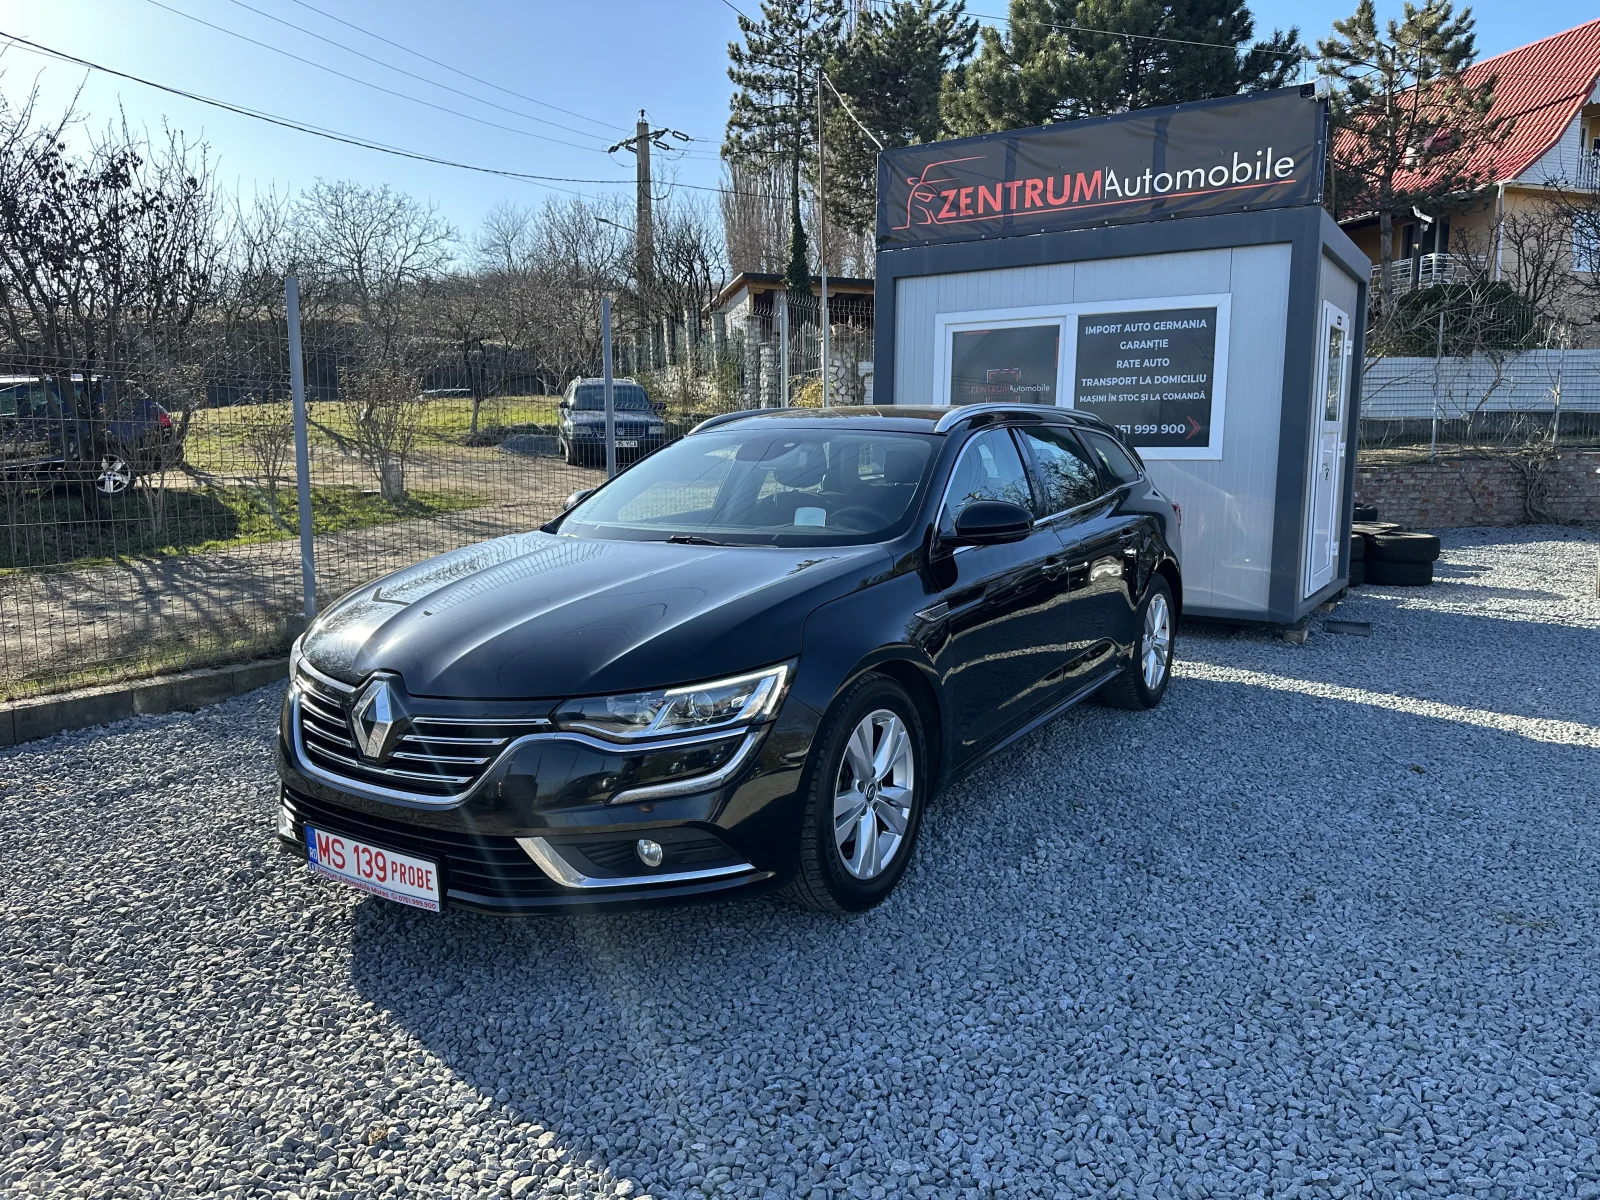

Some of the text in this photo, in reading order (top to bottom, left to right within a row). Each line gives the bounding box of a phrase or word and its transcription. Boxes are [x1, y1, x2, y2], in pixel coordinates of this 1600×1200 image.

[938, 147, 1295, 219] ZENTRUM Automobile
[1085, 319, 1207, 335] IMPORT AUTO GERMANIA
[1119, 339, 1169, 351] GARANȚIE
[1116, 358, 1170, 369] RATE AUTO
[1081, 374, 1207, 387] TRANSPORT LA DOMICILIU
[970, 383, 1050, 394] ZENTRUM Automobile
[1079, 390, 1206, 404] MAȘINI ÎN STOC ȘI LA COMANDĂ
[1134, 424, 1158, 435] 999
[1160, 423, 1186, 434] 900
[309, 832, 434, 892] RO MS 139 PROBE
[339, 875, 370, 892] Automobile
